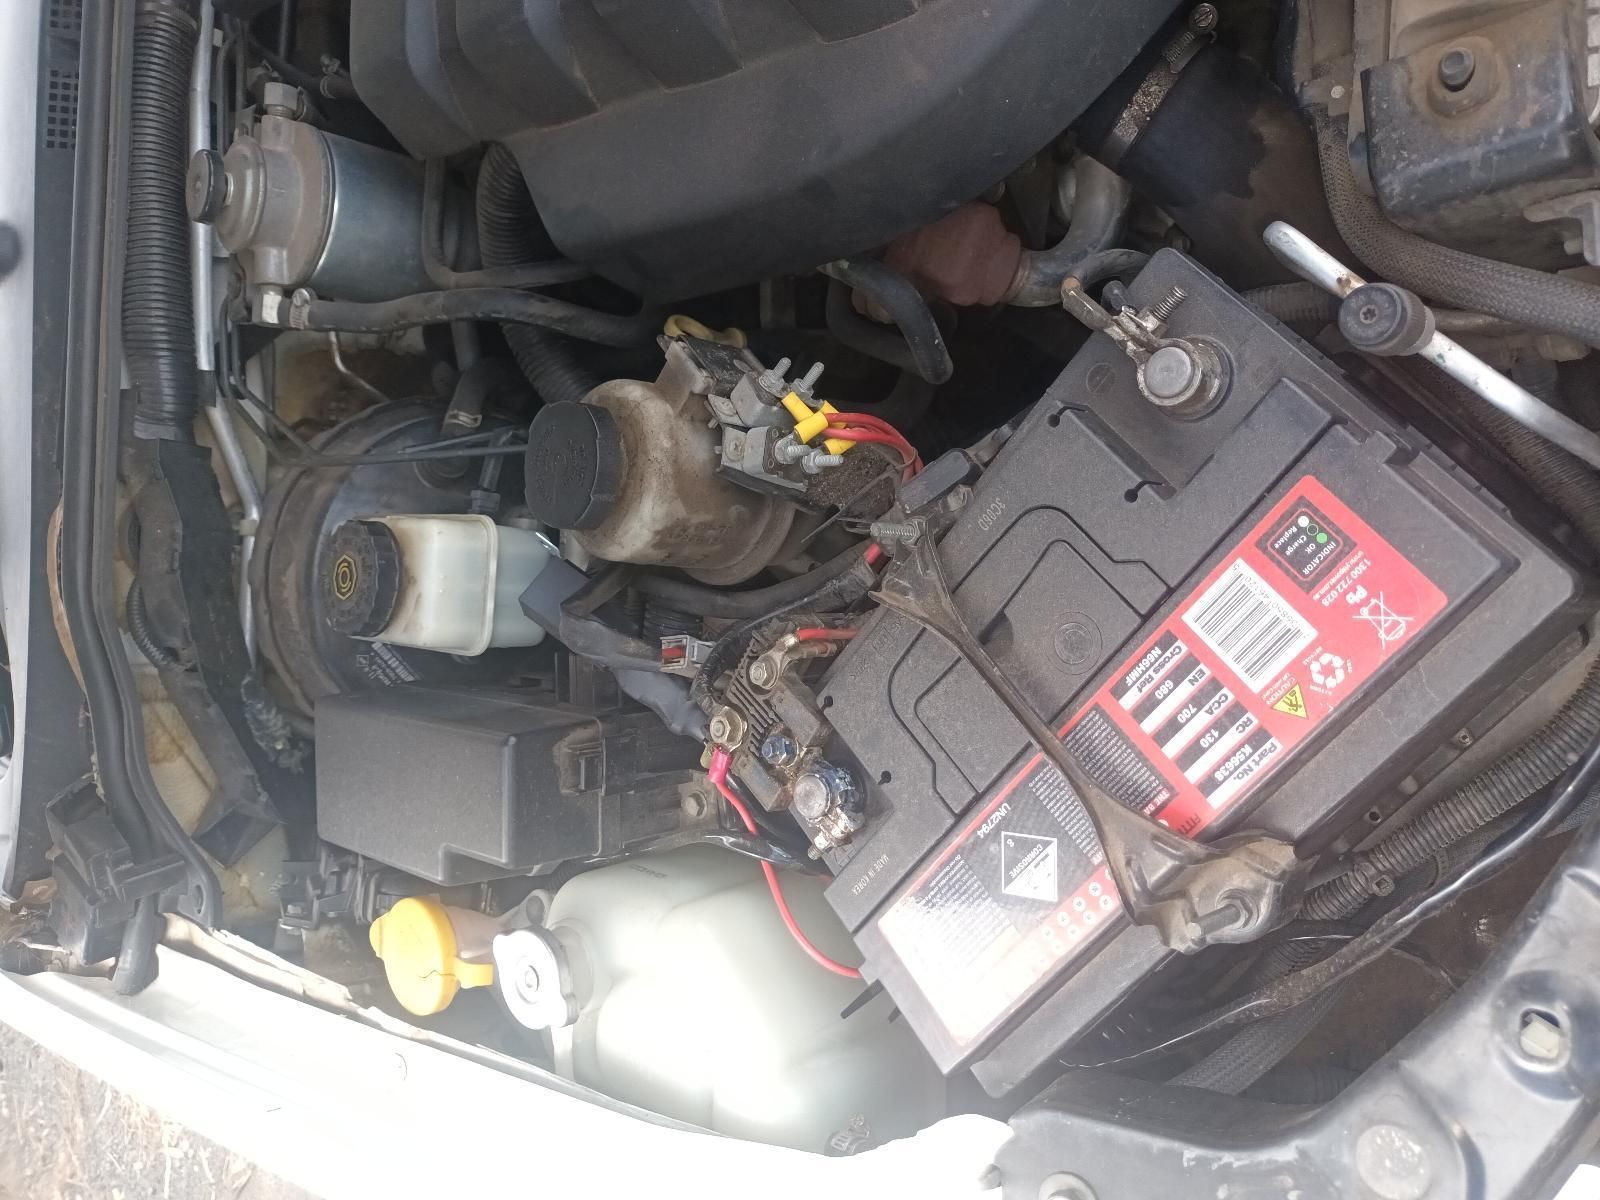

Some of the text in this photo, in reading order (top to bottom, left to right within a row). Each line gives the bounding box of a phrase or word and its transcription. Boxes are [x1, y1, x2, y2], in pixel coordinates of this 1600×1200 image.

[1272, 524, 1298, 550] Replace
[1283, 532, 1307, 557] Charge
[1304, 541, 1316, 554] OK
[1301, 540, 1336, 575] INDICATOR
[1320, 556, 1371, 607] 1300 722 028
[1343, 583, 1369, 608] Pb
[1122, 645, 1163, 686] N66HMF
[1134, 643, 1183, 694] Cross Ref
[1186, 667, 1206, 686] EN
[1152, 677, 1175, 700] 680
[1264, 675, 1296, 706] CAUTION
[1175, 702, 1197, 724] 700
[1203, 691, 1230, 717] CCA
[1197, 726, 1220, 749] 130
[1233, 715, 1254, 735] RC
[1212, 742, 1253, 782] K56638
[1232, 740, 1278, 784] Part No.
[974, 801, 1012, 839] UN2794
[1005, 837, 1015, 848] 8
[872, 853, 890, 872] MADE
[1007, 843, 1044, 879] CORROSIVE
[850, 873, 871, 896] KOREA
